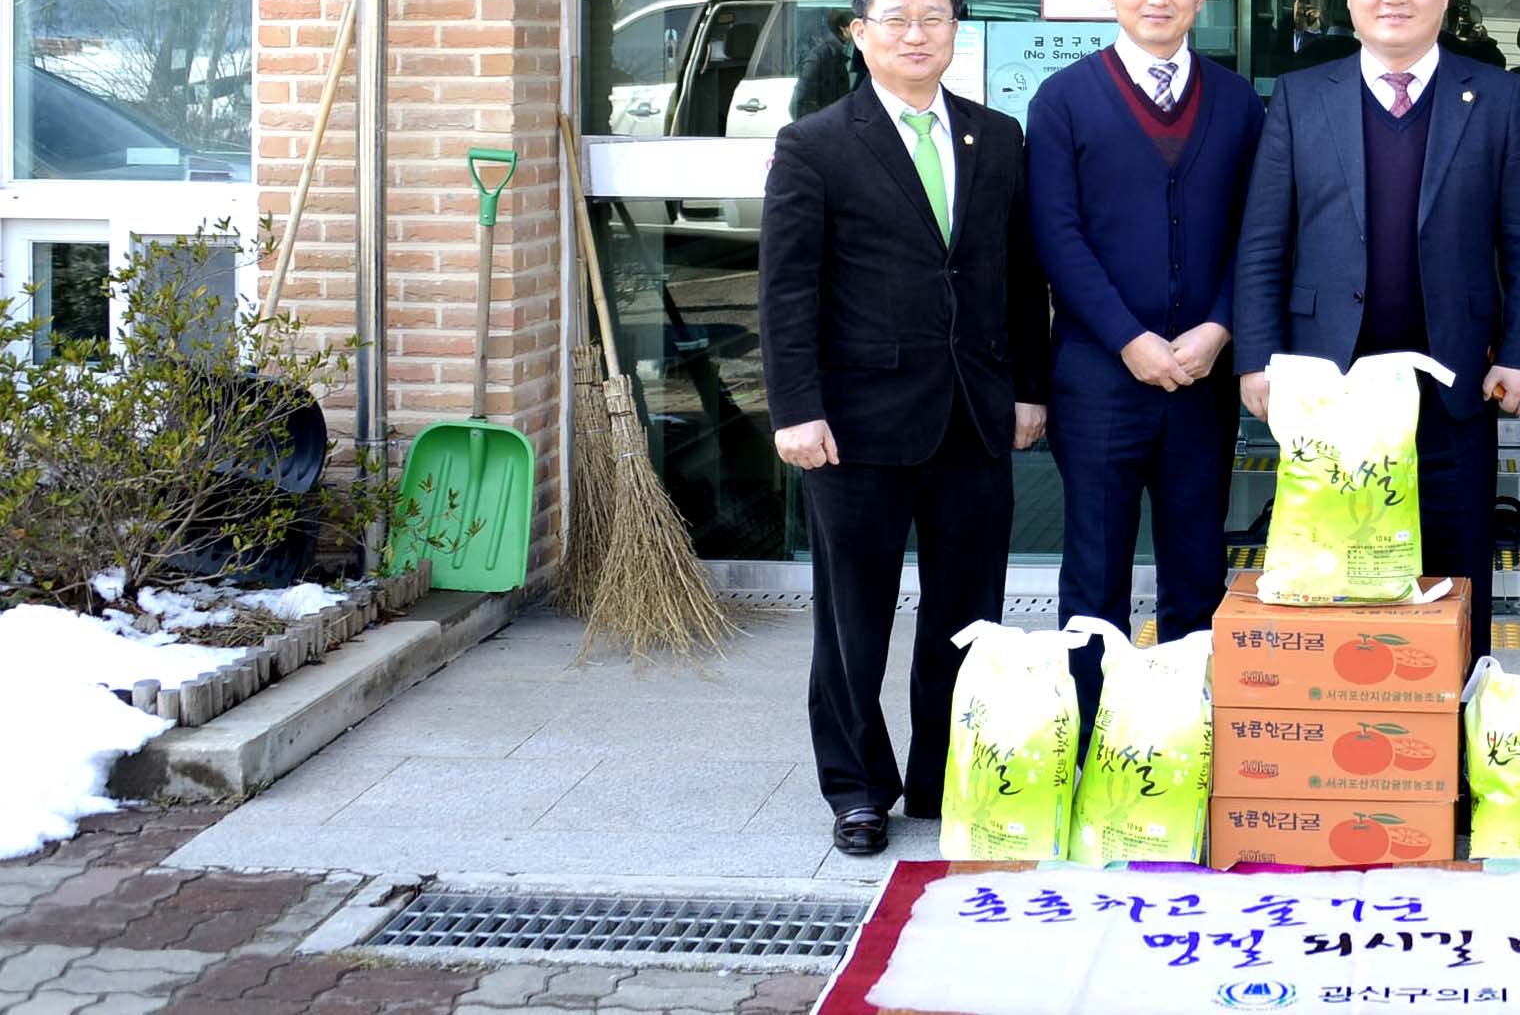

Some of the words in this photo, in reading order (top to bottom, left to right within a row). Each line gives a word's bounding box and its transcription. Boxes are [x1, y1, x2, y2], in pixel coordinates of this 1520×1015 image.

[1023, 50, 1046, 60] (No
[1142, 929, 1273, 968] 명절
[1302, 929, 1485, 968] 되시길
[1318, 984, 1508, 1005] 광산구의회
